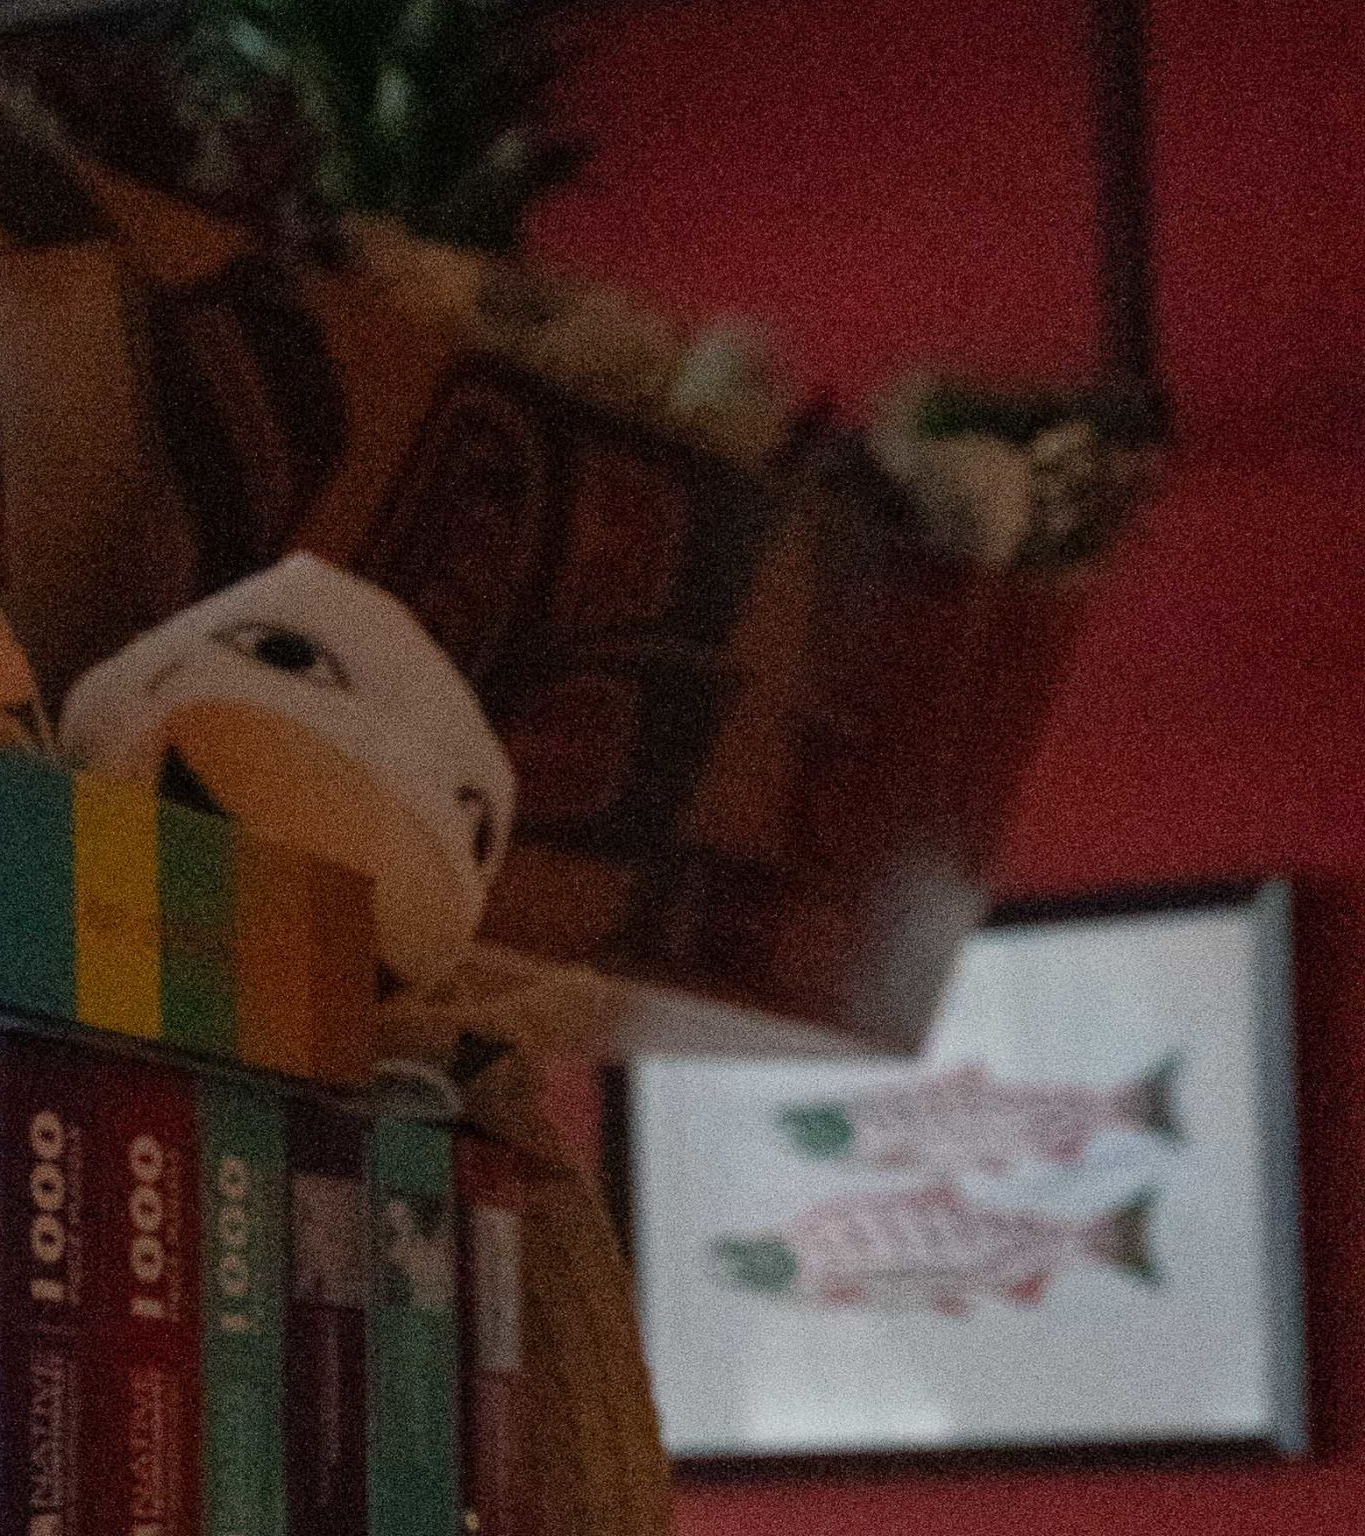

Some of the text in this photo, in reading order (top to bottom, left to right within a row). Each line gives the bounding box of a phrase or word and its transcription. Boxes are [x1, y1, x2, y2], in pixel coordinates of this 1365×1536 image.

[30, 1110, 65, 1302] 1000
[130, 1135, 165, 1318] 1000
[218, 1156, 249, 1332] 1000
